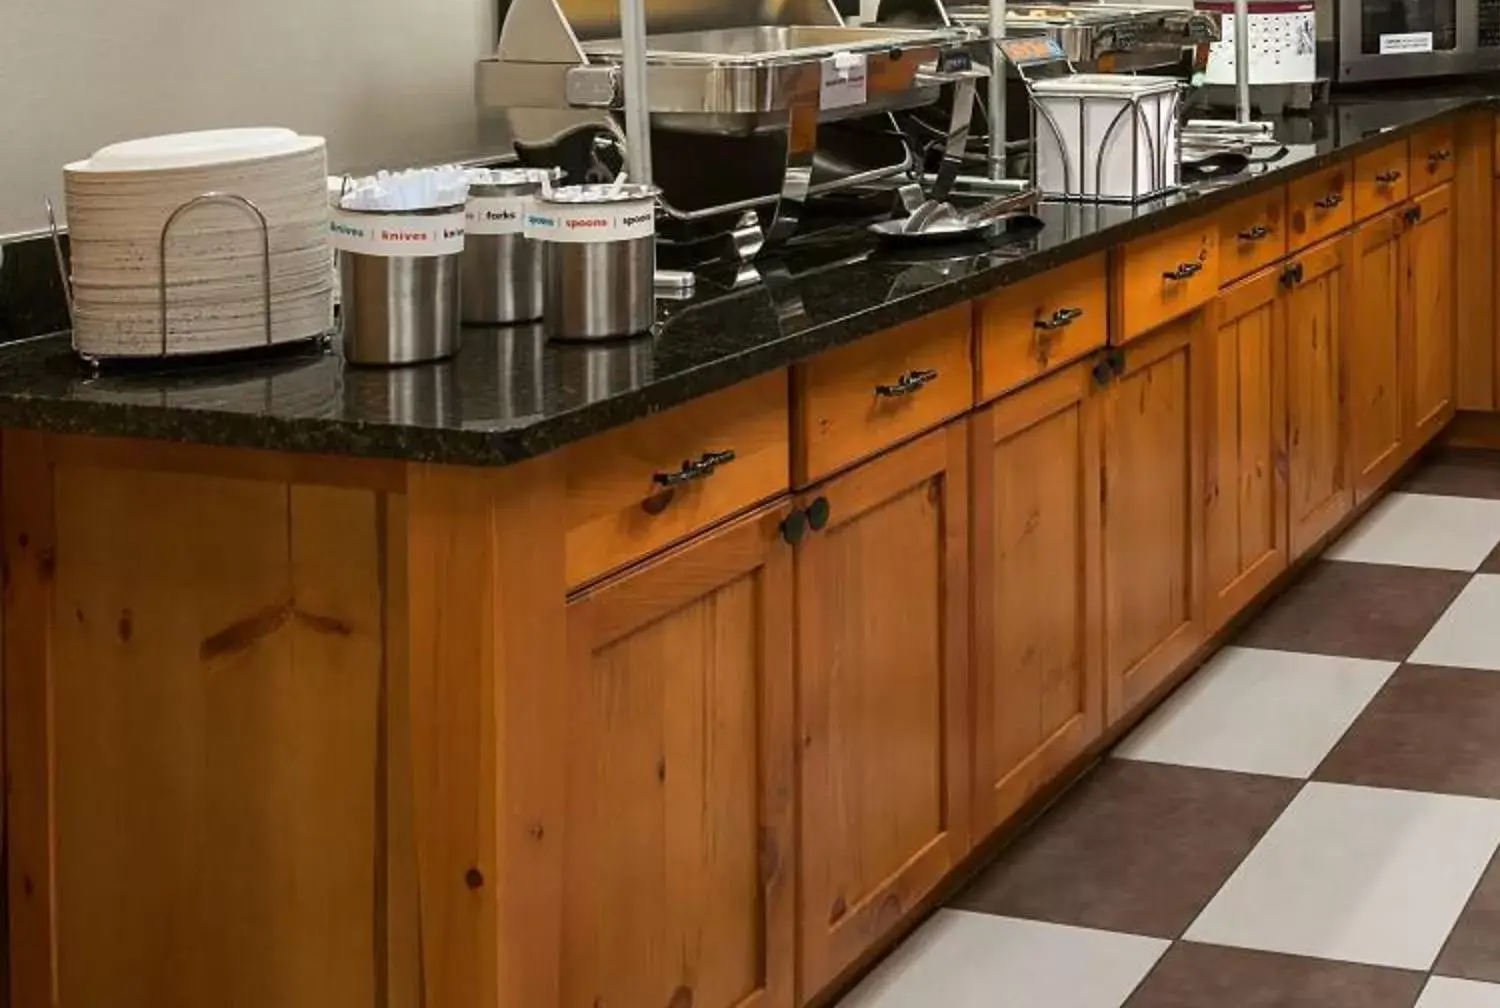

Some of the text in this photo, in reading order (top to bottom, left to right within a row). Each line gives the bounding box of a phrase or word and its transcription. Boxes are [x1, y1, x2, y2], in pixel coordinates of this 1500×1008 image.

[486, 210, 516, 221] forks
[566, 216, 608, 229] spoons
[381, 230, 427, 241] knives
